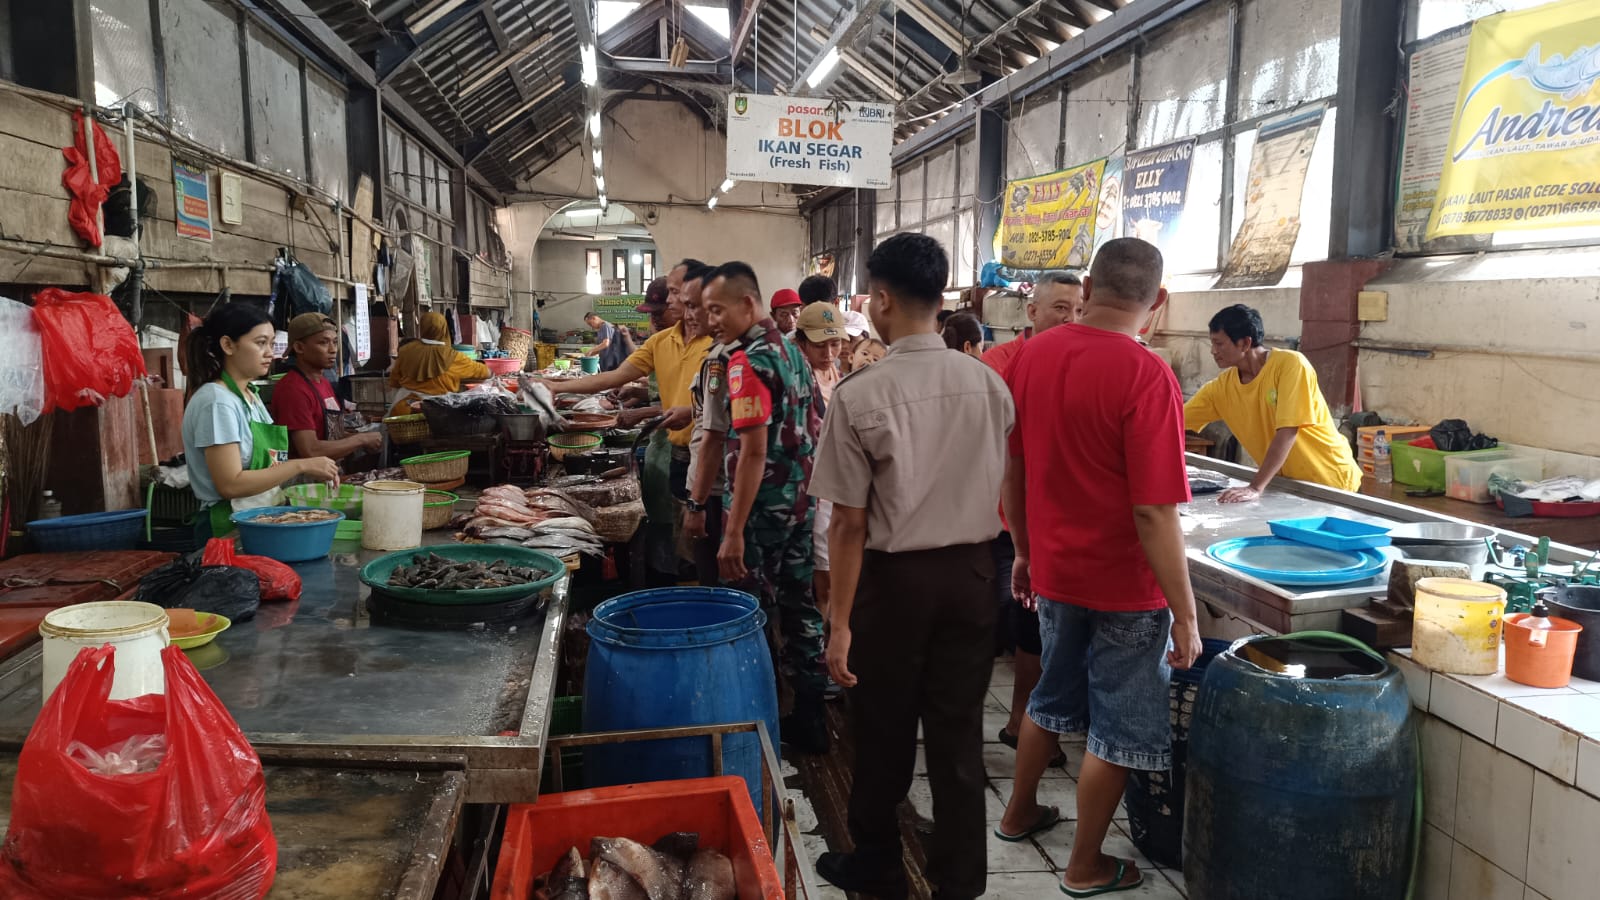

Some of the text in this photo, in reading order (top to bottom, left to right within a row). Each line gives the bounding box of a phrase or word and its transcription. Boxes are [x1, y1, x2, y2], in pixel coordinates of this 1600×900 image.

[778, 118, 846, 141] BLOK
[758, 139, 862, 159] IKAN SEGAR
[1535, 140, 1567, 150] TAWAR
[769, 155, 851, 173] (Fresh Fish)
[1134, 168, 1165, 190] ELLY
[1468, 190, 1496, 205] LAUT
[1495, 186, 1531, 202] PASAR
[1534, 183, 1568, 198] GEDE
